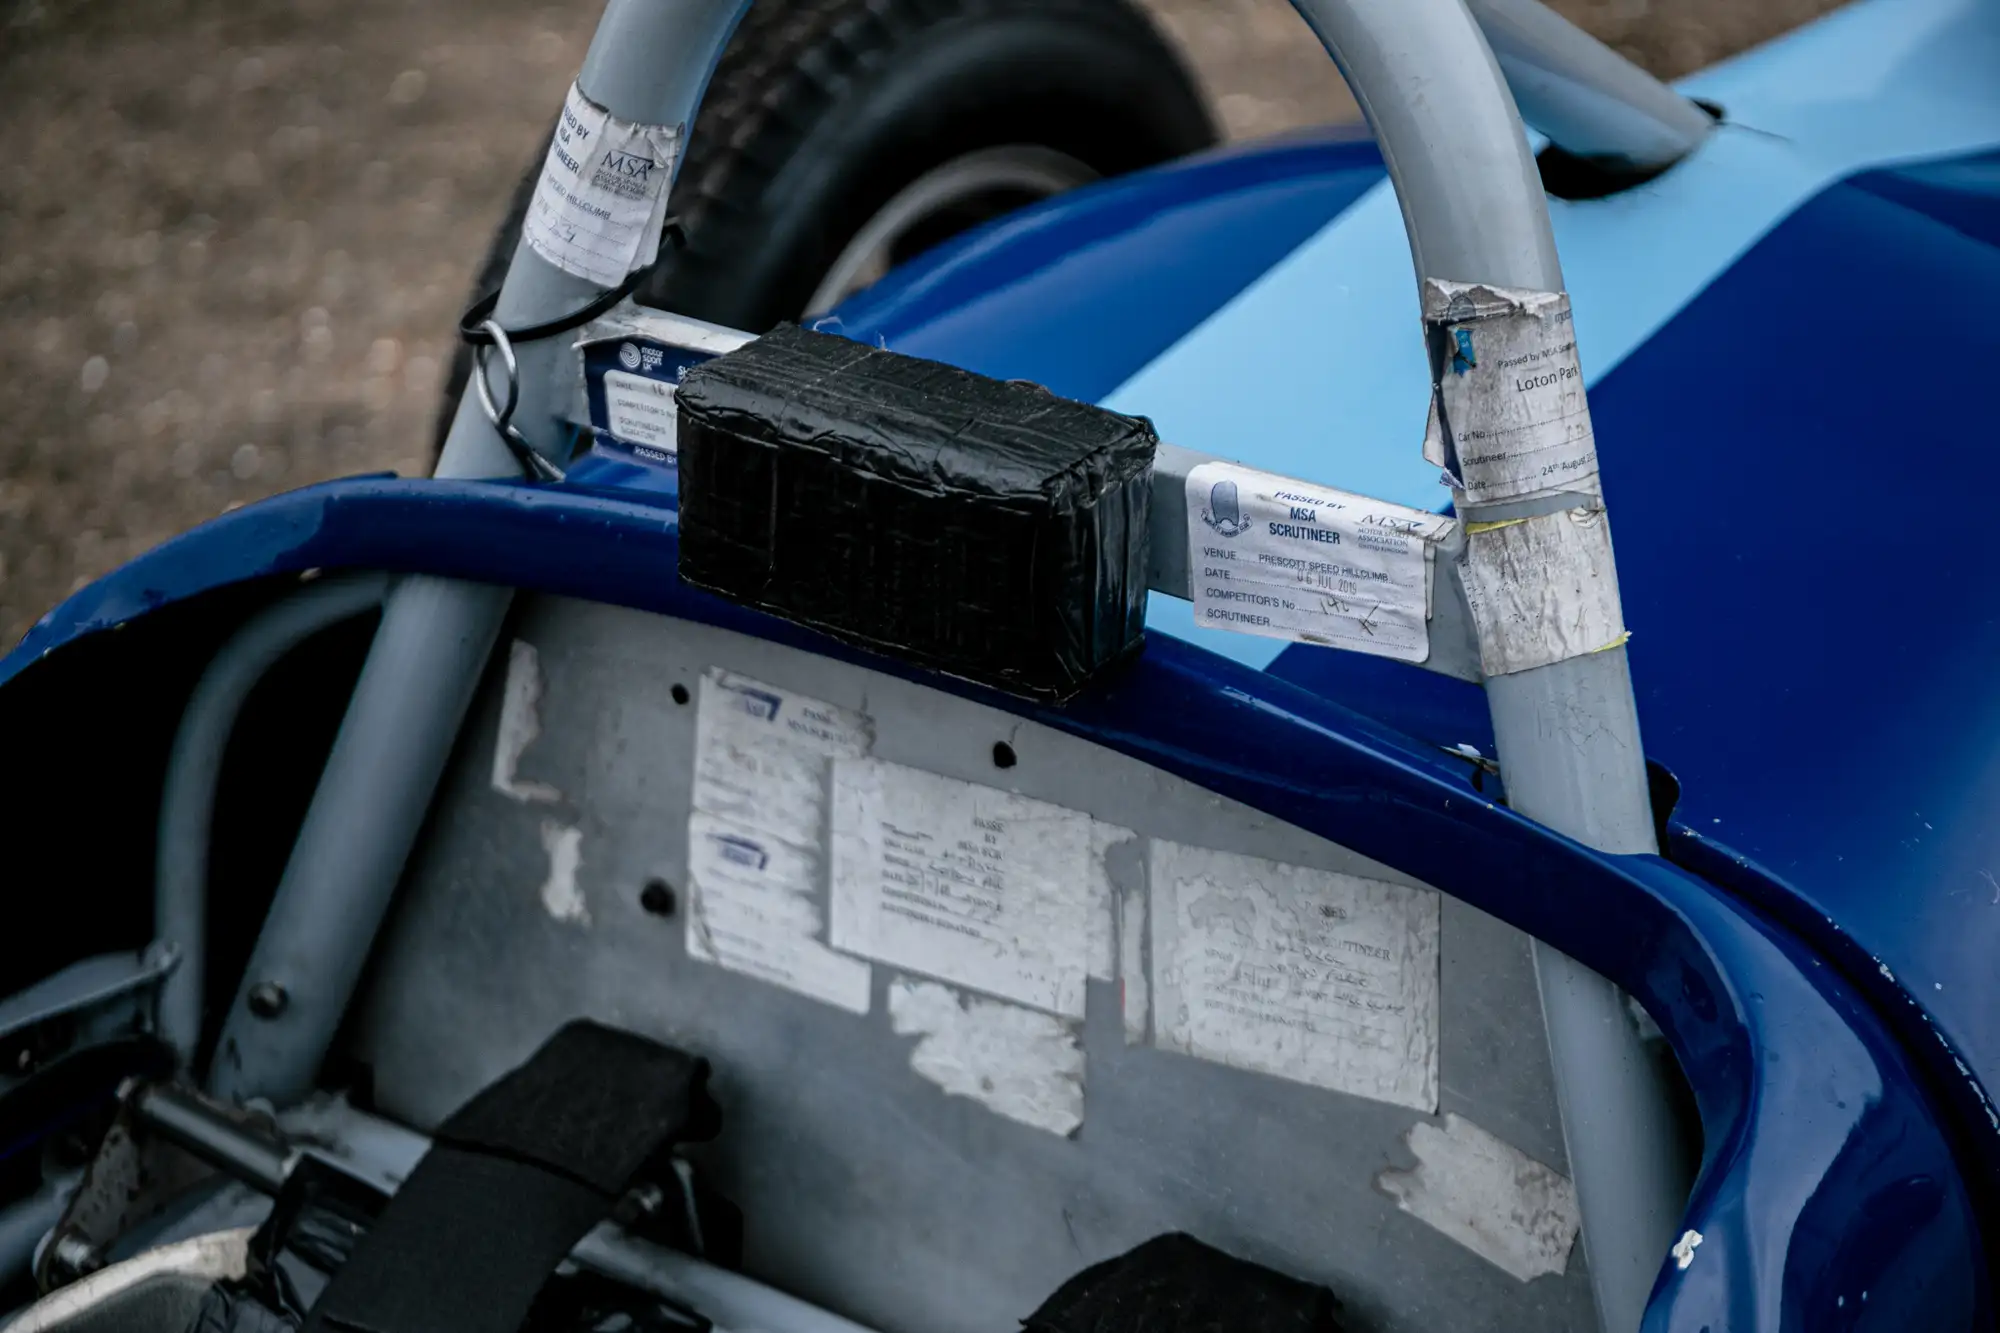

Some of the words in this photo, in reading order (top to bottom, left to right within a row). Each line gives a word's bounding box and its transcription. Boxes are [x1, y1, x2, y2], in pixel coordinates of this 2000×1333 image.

[576, 124, 590, 140] BY
[601, 150, 648, 181] MSA
[1497, 355, 1528, 369] Passed
[1529, 352, 1540, 362] by
[1516, 373, 1558, 392] Loton
[1559, 363, 1579, 381] Park
[1458, 432, 1471, 442] Car
[1462, 451, 1507, 467] Scrutineer
[1468, 480, 1486, 491] Date
[1562, 455, 1586, 471] August
[1274, 490, 1325, 506] PASSED
[1290, 506, 1317, 523] MSA
[1269, 522, 1341, 545] SCRUTINEER
[1358, 535, 1409, 548] ASSOCIATION
[1203, 546, 1237, 560] VENUE
[1258, 553, 1307, 569] PRESCOTT
[1309, 561, 1340, 575] SPEED
[1342, 567, 1389, 582] HILLCLIMB
[1205, 567, 1231, 580] DATE
[1317, 574, 1335, 590] JUL
[1206, 587, 1280, 608] COMPETITOR'S
[1207, 608, 1271, 627] SCRUTINEER
